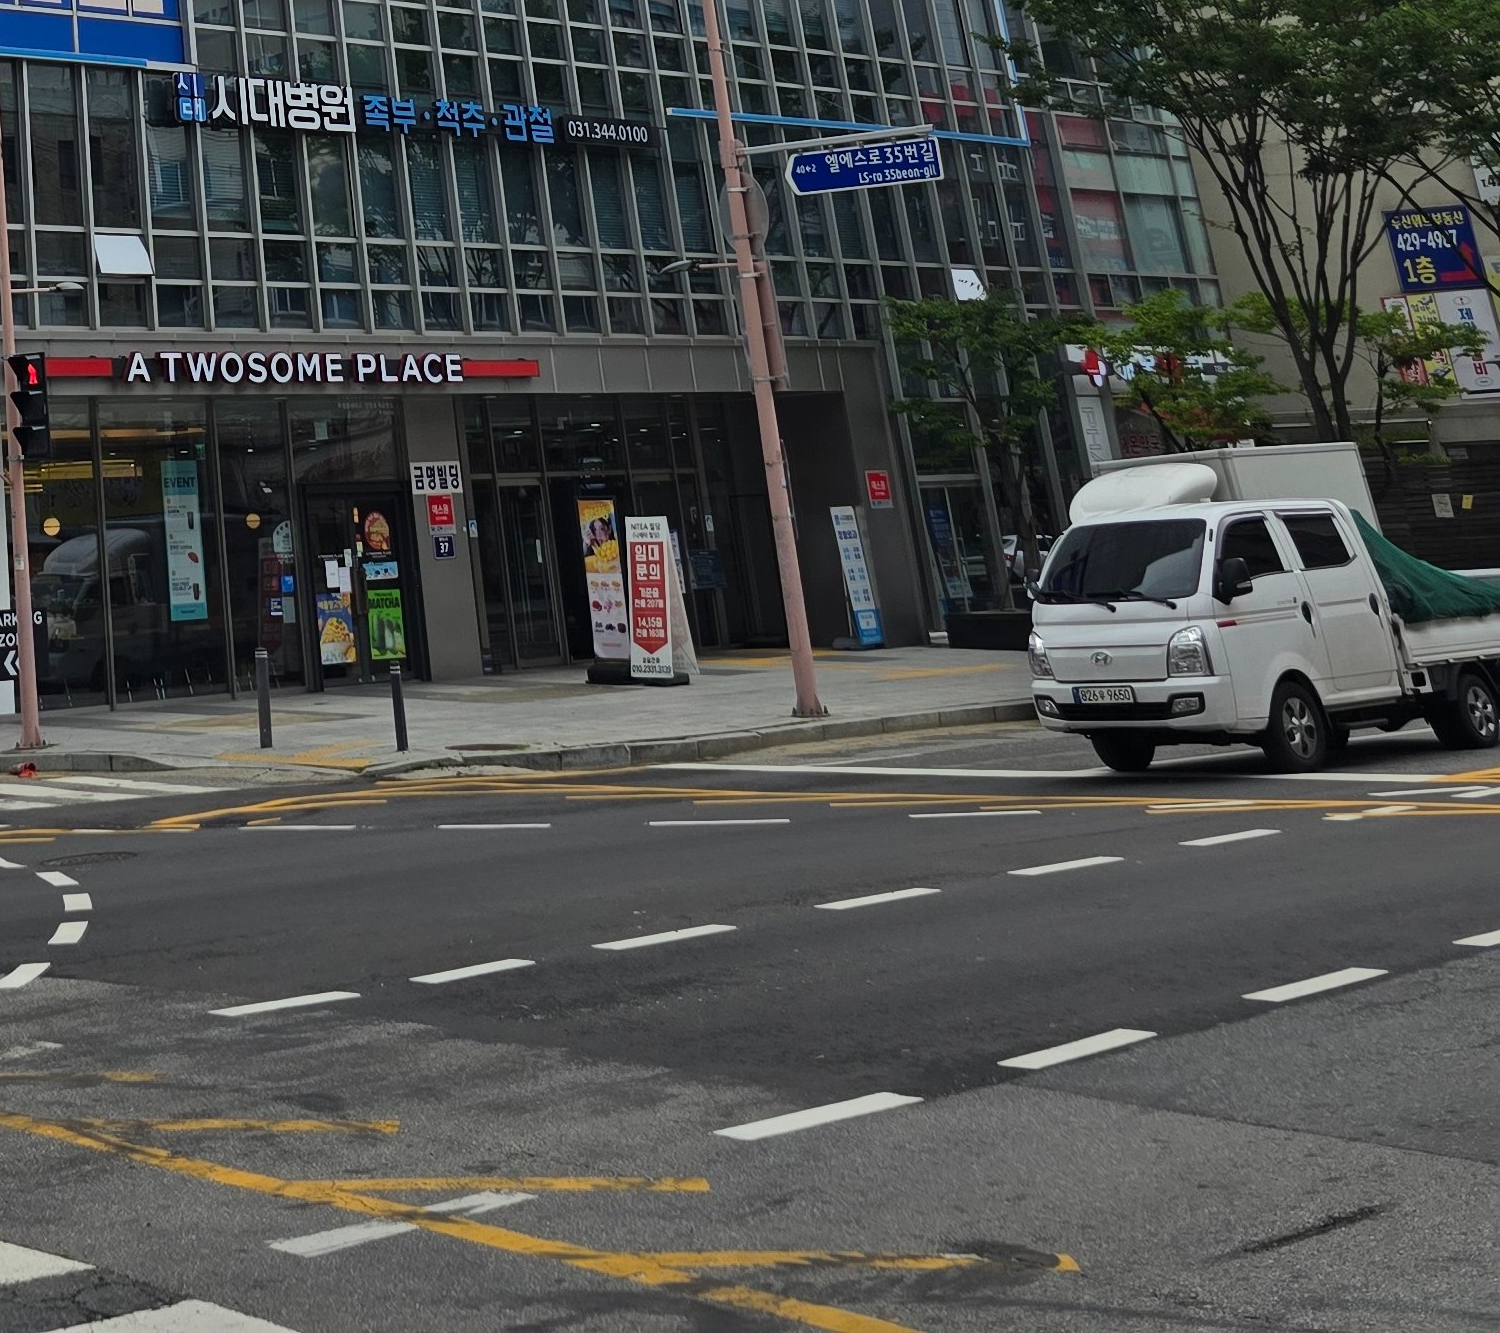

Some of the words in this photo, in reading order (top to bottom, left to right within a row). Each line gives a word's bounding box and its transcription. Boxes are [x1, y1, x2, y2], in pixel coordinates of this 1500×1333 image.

[212, 74, 357, 133] 시대병원
[567, 119, 649, 144] 031.344.0100
[858, 170, 883, 184] LS-ro
[884, 164, 937, 181] 35beon-gil
[1403, 255, 1437, 284] 1층
[126, 352, 151, 382] A
[159, 351, 344, 383] TWOSOME
[357, 353, 464, 383] PLACE
[163, 476, 196, 489] EVENT
[413, 464, 460, 491] 금명빌딩
[439, 542, 449, 553] 37
[634, 544, 660, 562] 임대
[636, 563, 661, 581] 문의
[368, 596, 400, 610] MATCHA
[1106, 688, 1131, 701] 9650
